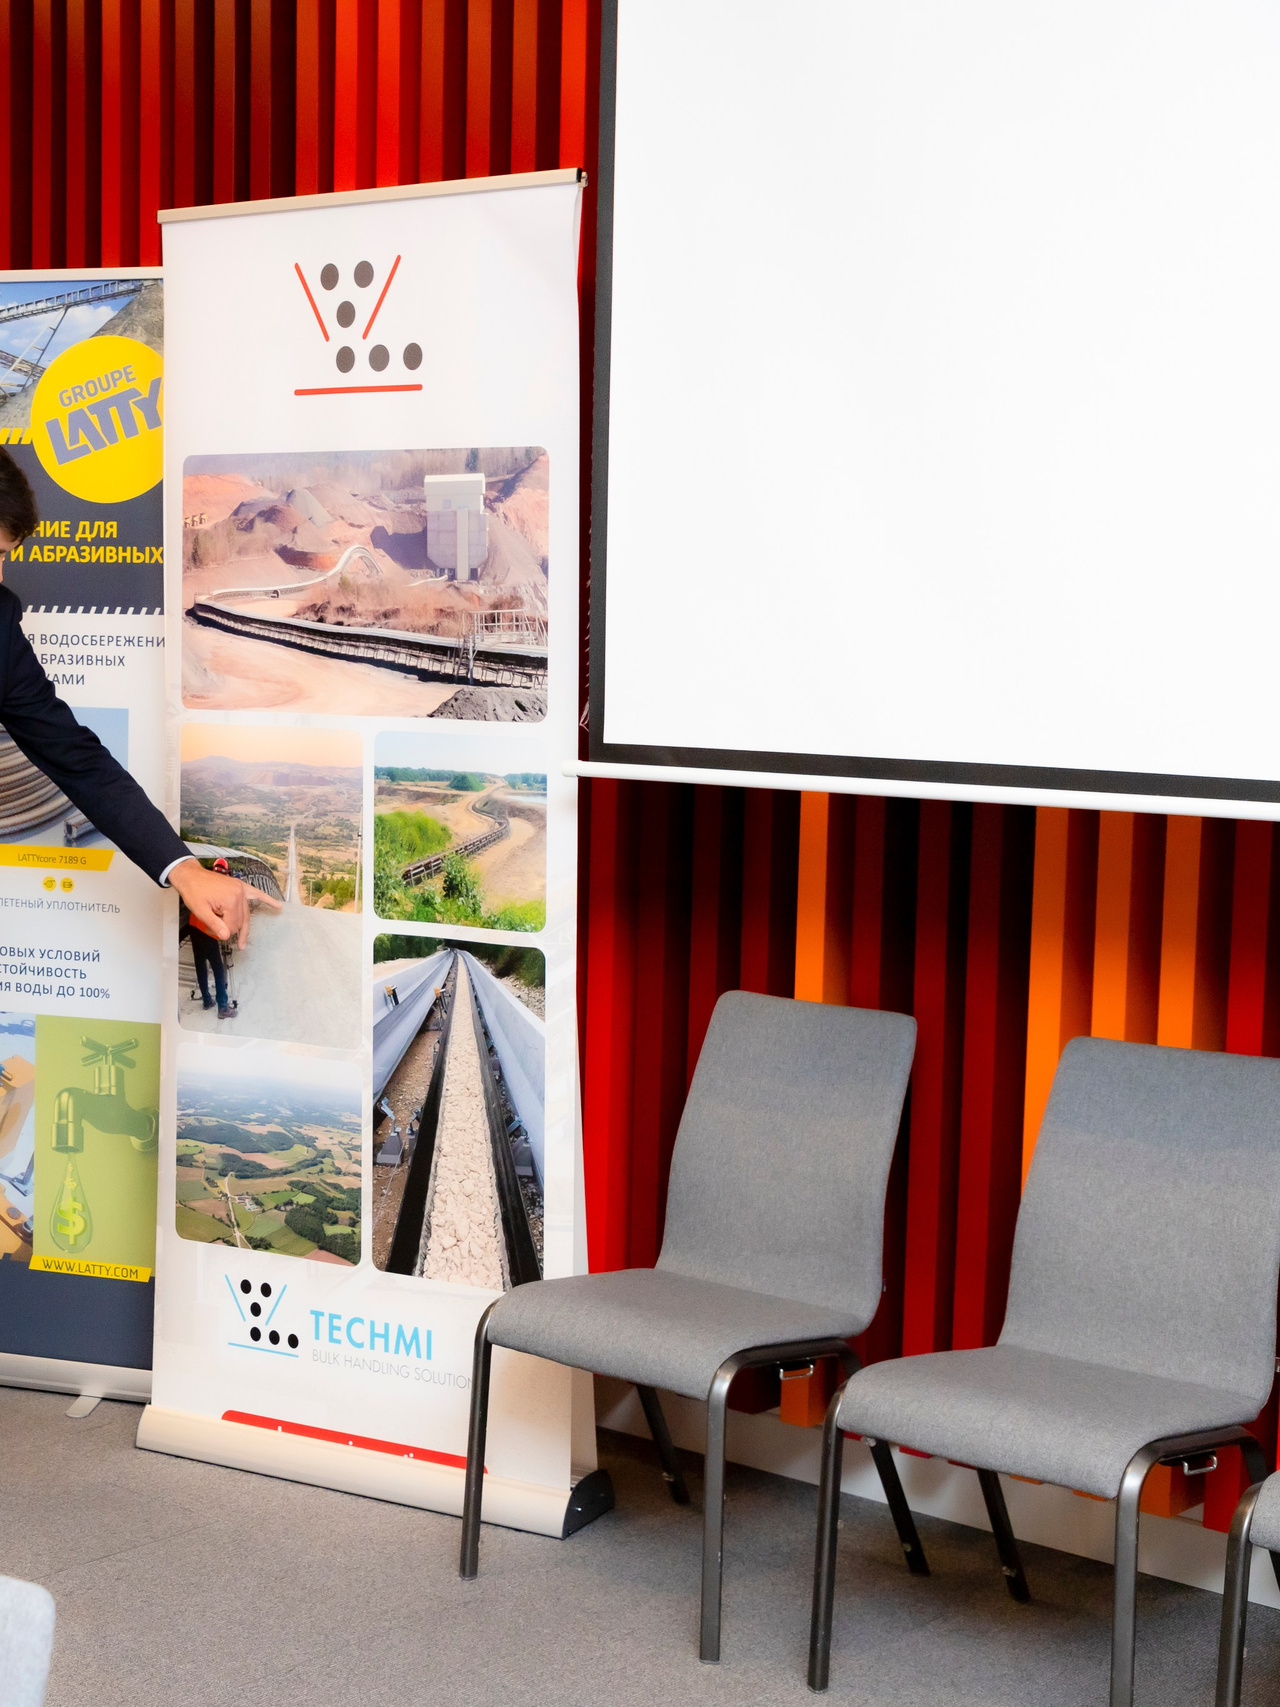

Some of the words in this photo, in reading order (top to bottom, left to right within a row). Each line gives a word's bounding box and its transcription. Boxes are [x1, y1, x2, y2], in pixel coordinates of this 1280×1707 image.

[58, 364, 137, 408] GROUPE
[45, 376, 162, 466] LATTY
[32, 520, 71, 538] НИЕ
[75, 520, 118, 542] ДЛЯ
[29, 545, 164, 564] АБРАЗИВНЫХ
[40, 653, 126, 667] БРАЗИВНЫХ
[59, 855, 78, 865] 7189
[80, 856, 87, 865] G
[46, 900, 121, 914] УПЛОТНИТЕЛЬ
[39, 949, 101, 963] УСЛОВИЙ
[15, 982, 53, 996] ВОДЫ
[56, 985, 75, 998] ДО
[79, 986, 110, 999] 100%
[42, 1258, 139, 1280] WWW.LATTY.COM
[310, 1309, 432, 1361] TECHMI
[312, 1348, 340, 1366] BULK
[344, 1354, 410, 1379] HANDLING
